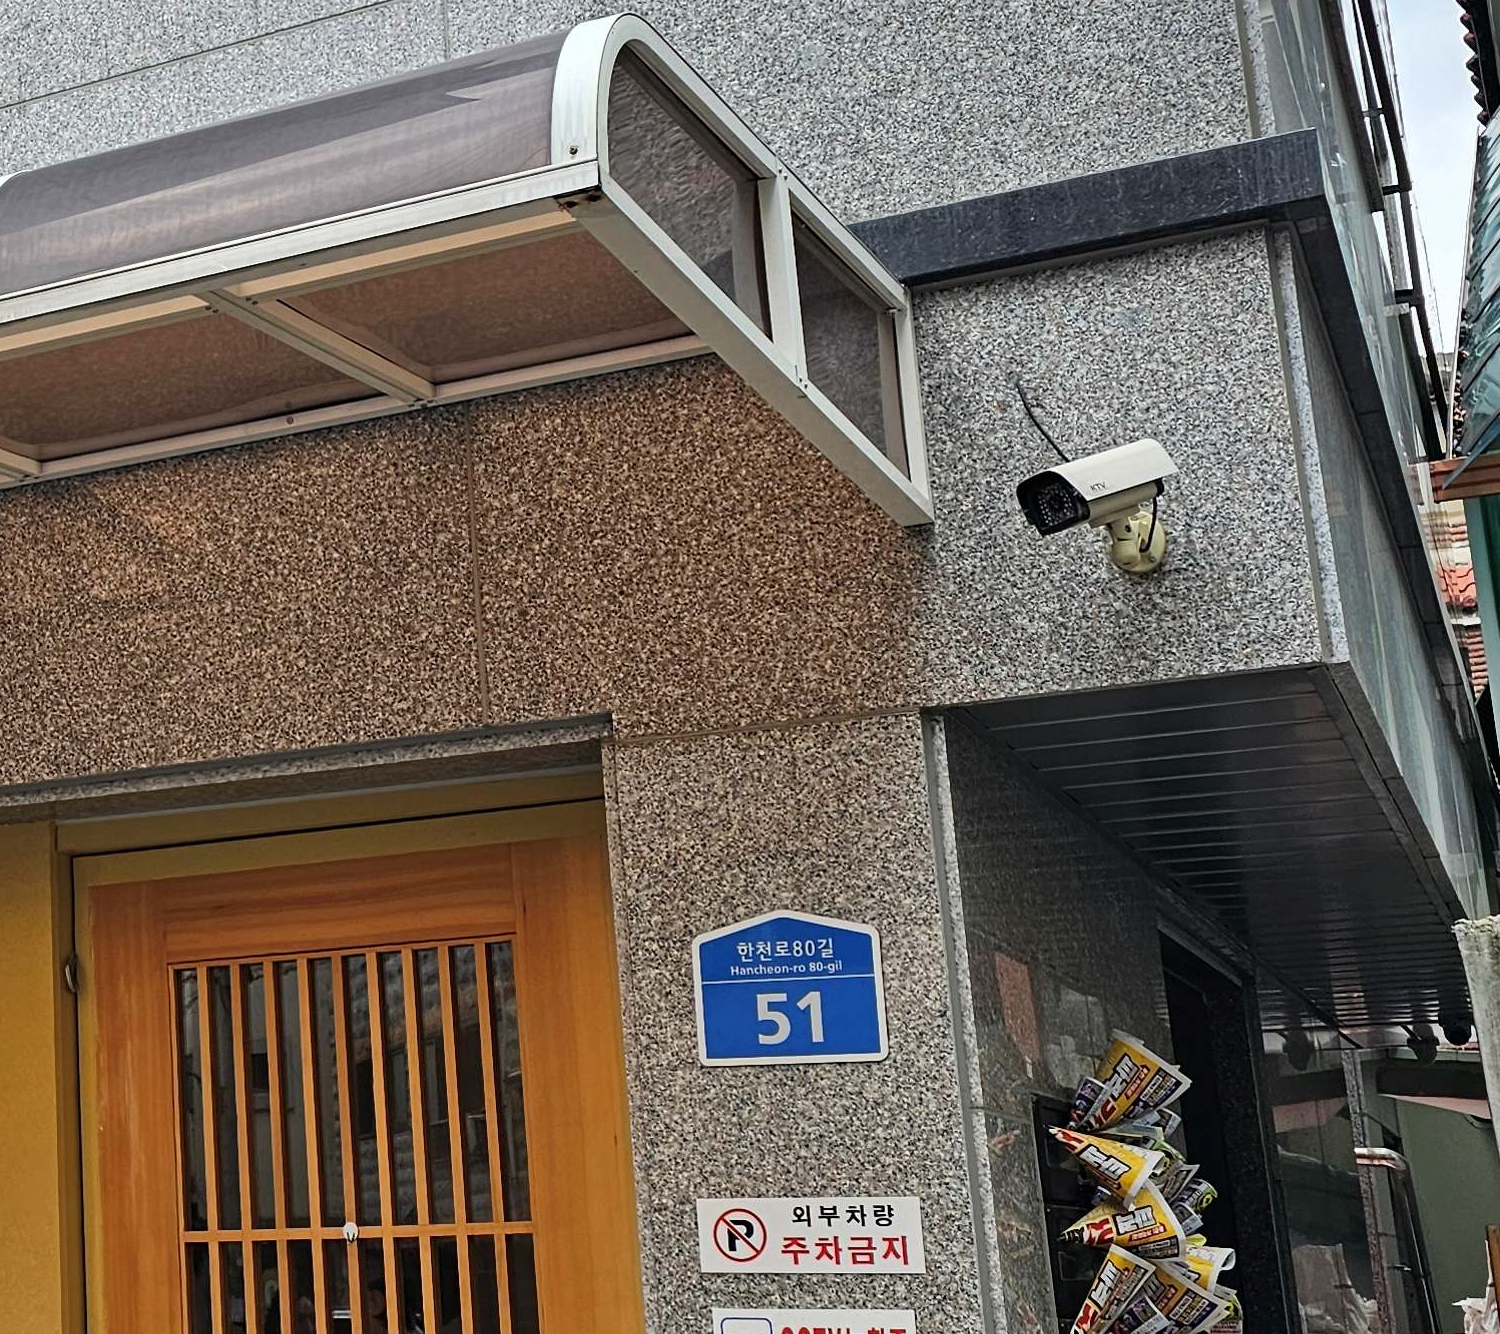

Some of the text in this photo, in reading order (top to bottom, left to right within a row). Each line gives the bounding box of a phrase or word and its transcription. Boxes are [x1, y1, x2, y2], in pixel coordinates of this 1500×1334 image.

[736, 938, 834, 963] 한천로80길
[730, 960, 843, 976] Hancheon-ro 80-gil
[756, 991, 824, 1045] 51
[791, 1204, 895, 1228] 외부차량
[781, 1235, 910, 1265] 주차금지
